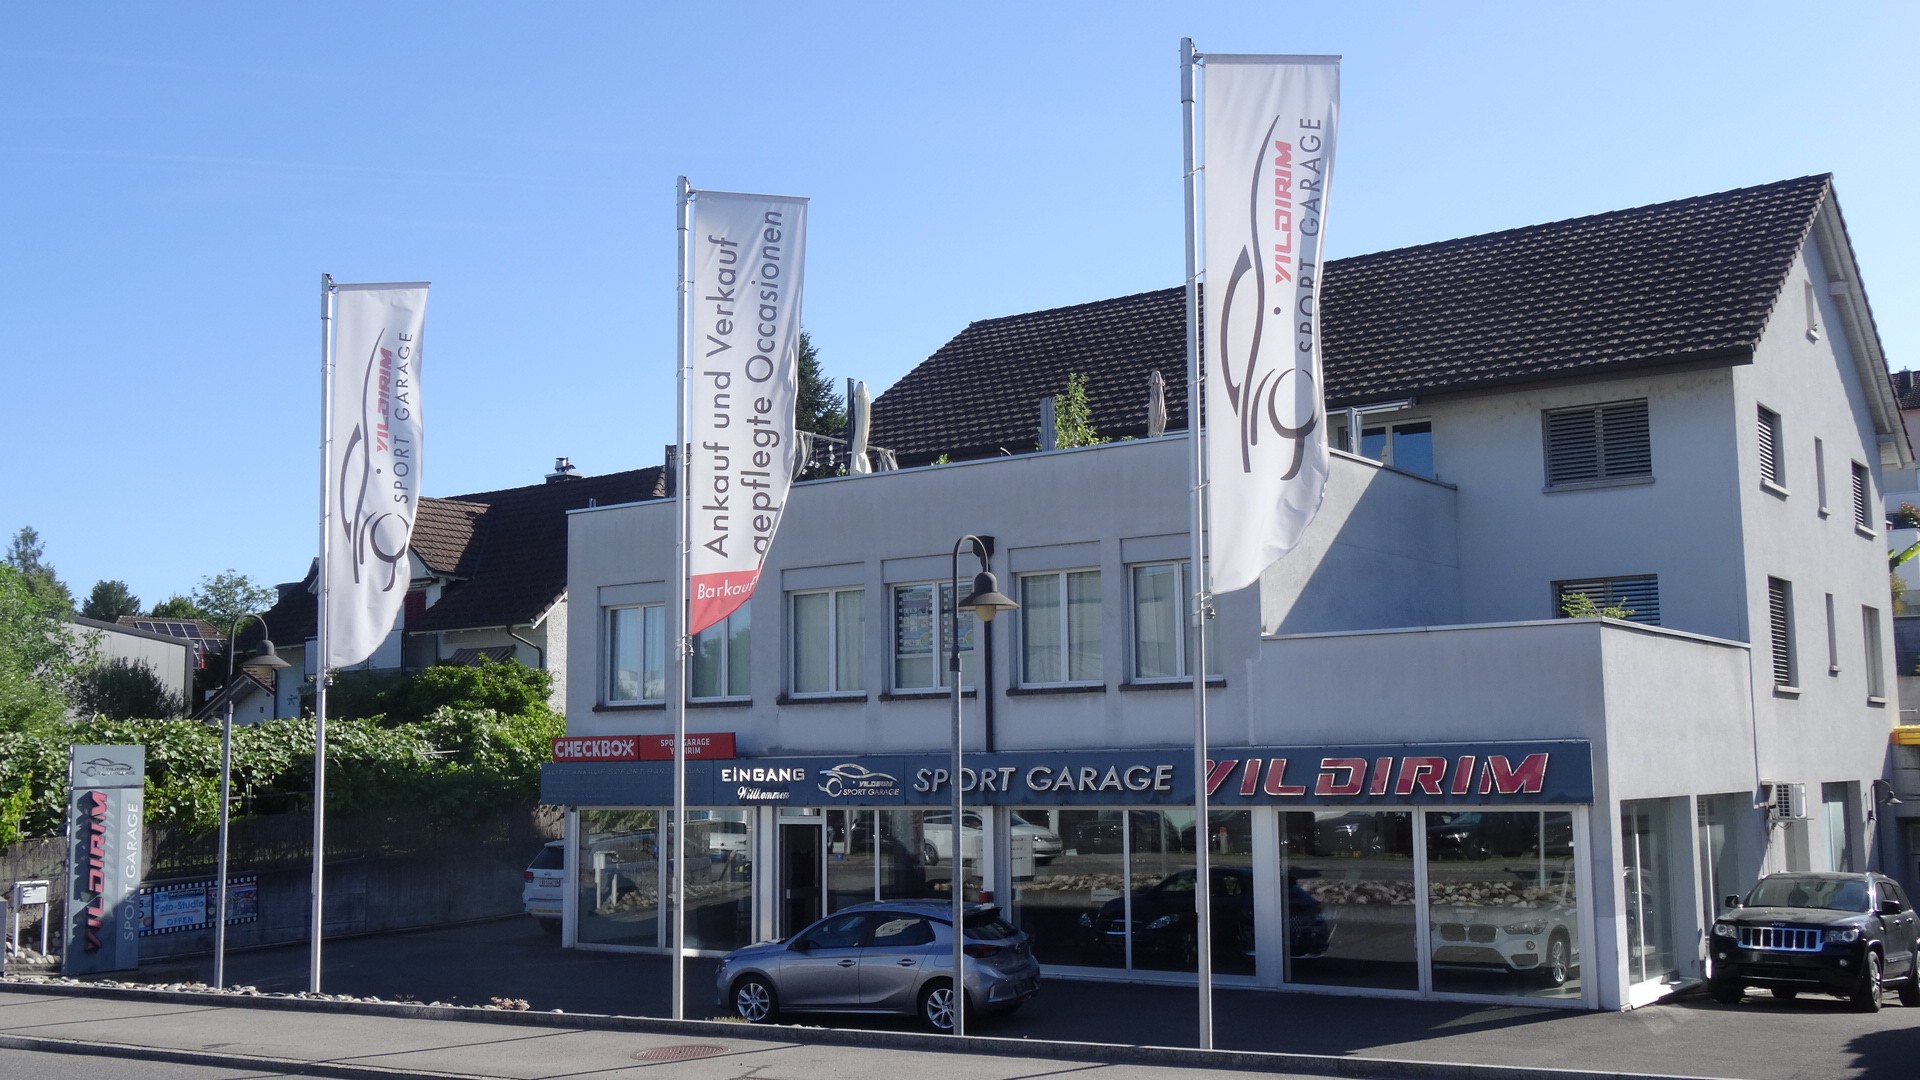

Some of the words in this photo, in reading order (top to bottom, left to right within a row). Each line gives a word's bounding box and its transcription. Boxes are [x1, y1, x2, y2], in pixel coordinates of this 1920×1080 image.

[1299, 118, 1321, 236] GARAGE
[1274, 140, 1292, 284] YILDIRIM
[705, 235, 738, 357] Verkauf
[745, 211, 782, 383] Occasionen
[1299, 258, 1316, 352] SPORT
[376, 347, 393, 453] YILDIRIM
[394, 332, 413, 421] GARAGE
[703, 371, 731, 429] und
[393, 435, 410, 504] SPORT
[702, 441, 730, 558] Ankauf
[697, 576, 757, 600] Barkauf
[670, 747, 701, 755] YIRIM
[913, 766, 1016, 792] SPORT
[1026, 764, 1174, 791] GARAGE
[1206, 753, 1549, 796] YILDIRIM
[737, 785, 790, 800] Willkommen
[842, 788, 866, 796] SPORT
[868, 788, 900, 796] GARAGE
[85, 791, 107, 949] YILDIRIM
[126, 802, 139, 878] GARAGE
[123, 883, 136, 941] SPORT
[155, 900, 204, 912] Foto-Studio
[166, 916, 194, 926] OFFEN
